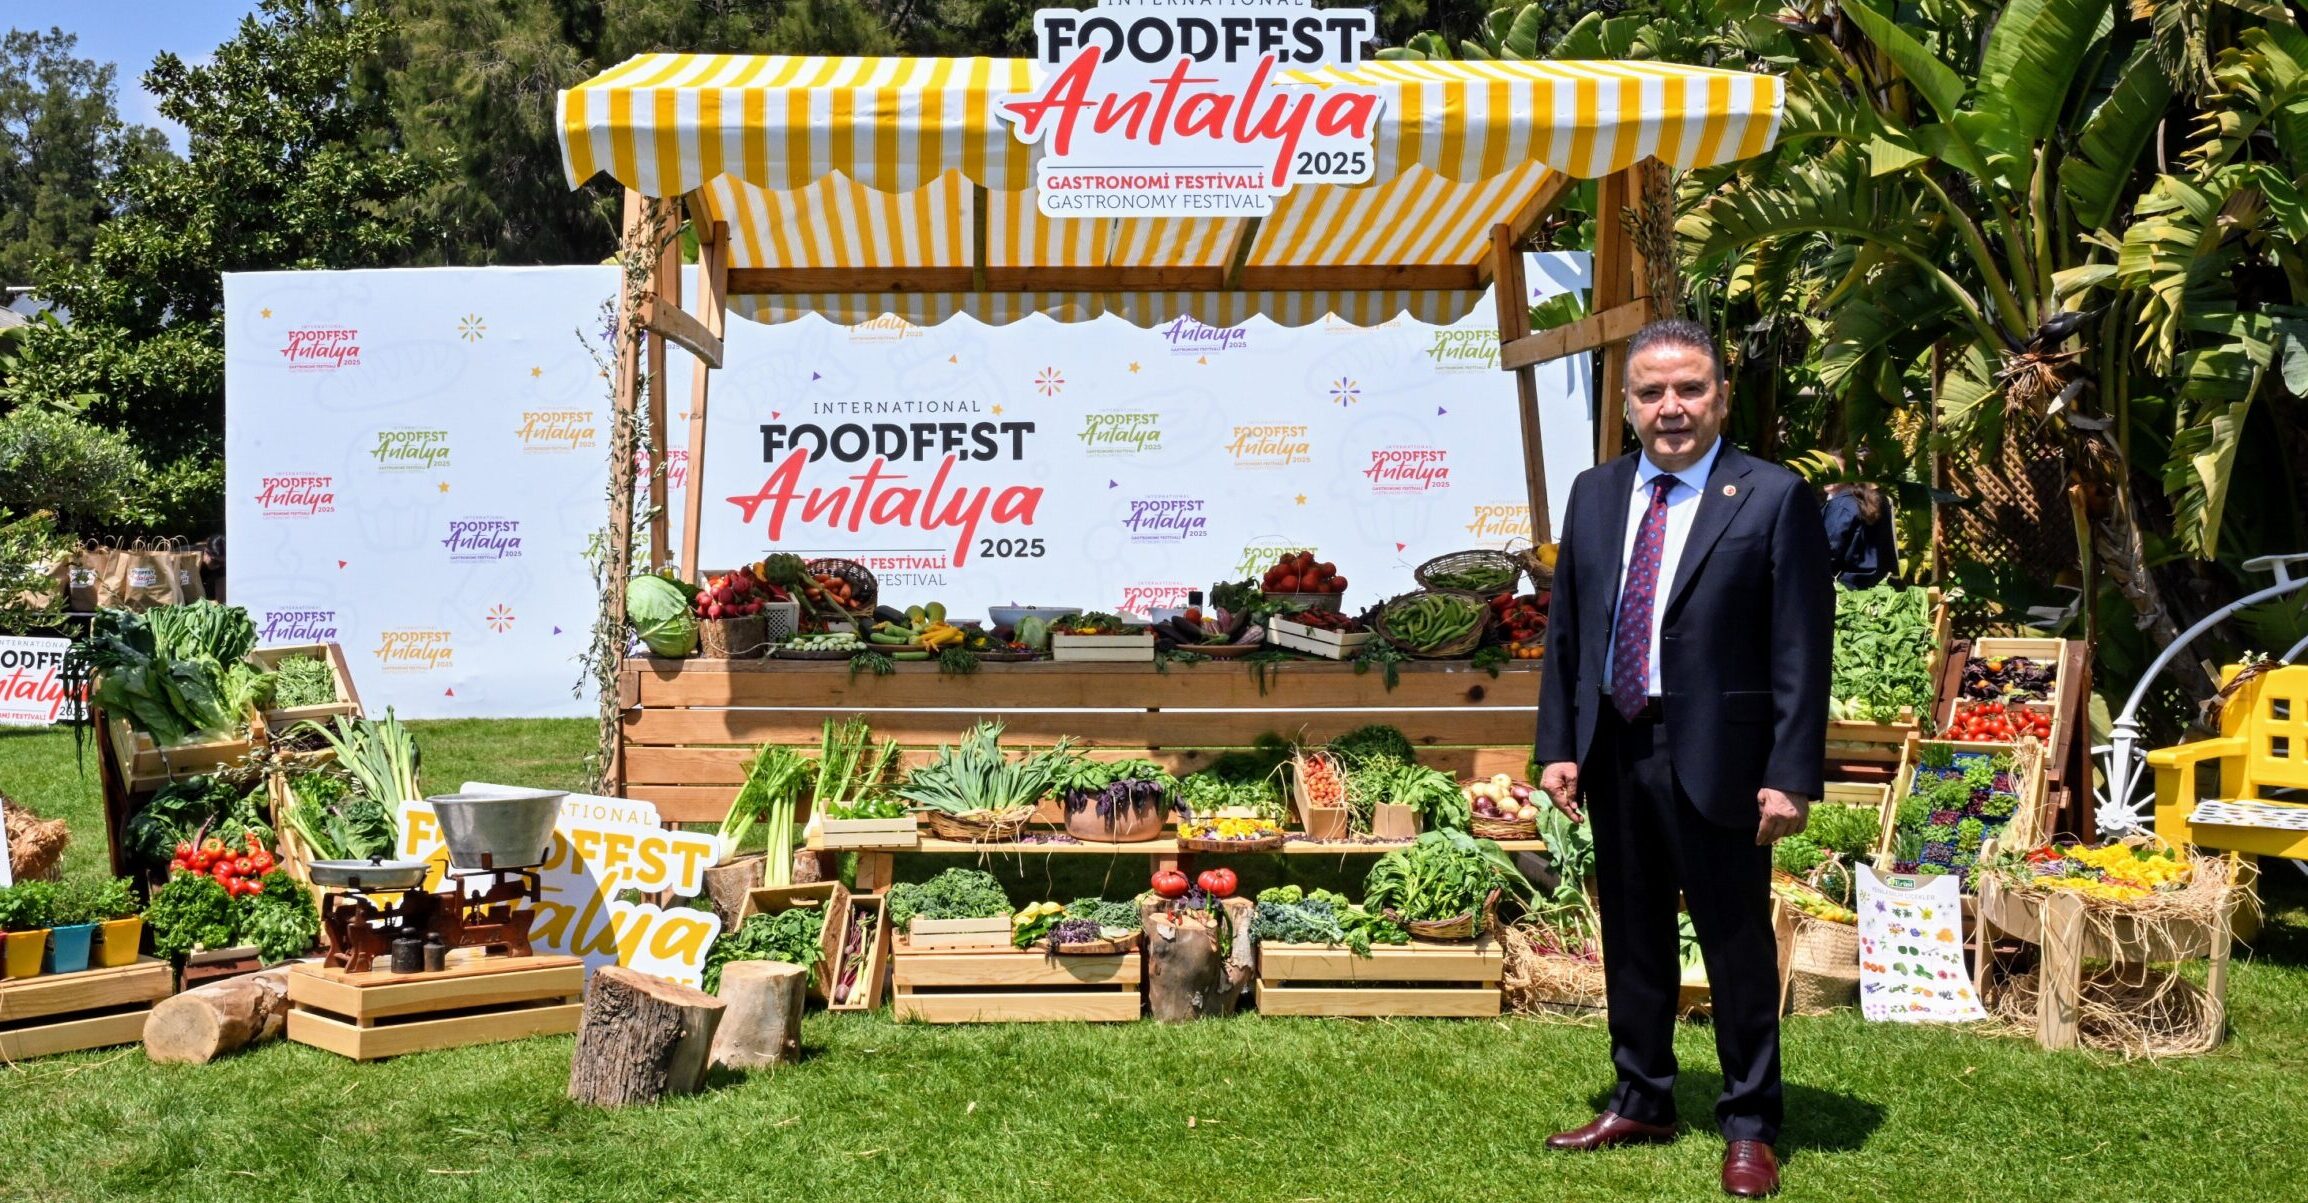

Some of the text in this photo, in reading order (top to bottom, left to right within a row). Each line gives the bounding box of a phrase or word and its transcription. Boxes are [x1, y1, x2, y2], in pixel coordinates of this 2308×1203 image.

[1043, 16, 1367, 64] FOODFEST
[1003, 45, 1377, 188] Antalya
[1296, 151, 1366, 175] 2025
[1046, 172, 1264, 190] GASTRONOMİ FESTİVALİ
[1047, 194, 1264, 209] GASTRONOMY FESTIVAL
[288, 330, 358, 341] FOODFEST
[1434, 330, 1500, 341] FOODFES
[280, 336, 360, 367] Antalya
[1426, 337, 1499, 369] Antaly
[523, 412, 593, 422] FOODFEST
[814, 400, 981, 415] INTERNATIONAL
[1085, 414, 1159, 425] FOODFEST
[378, 431, 448, 442] FOODFEST
[514, 420, 596, 449] Antalya
[1077, 421, 1161, 452] Antalya
[1233, 426, 1307, 437] FOODFEST
[760, 421, 1036, 463] FOODFEST
[1224, 434, 1310, 465] Antalya
[369, 439, 450, 469] Antalya
[1371, 450, 1447, 461] FOODFEST
[262, 477, 332, 488] FOODFEST
[1362, 457, 1449, 490] Antalya
[254, 484, 335, 515] Antalya
[725, 447, 1044, 568] Antalya
[1131, 500, 1205, 511] FOODFEST
[449, 521, 519, 532] FOODFEST
[1122, 507, 1207, 539] Antalya
[441, 528, 522, 559] Antalya
[980, 538, 1046, 558] 2025
[870, 554, 947, 569] FESTİVALİ
[878, 573, 947, 586] FESTIVAL
[266, 611, 336, 622] FOODFEST
[258, 618, 337, 643] Antalya
[382, 632, 451, 642] FOODFEST
[373, 640, 453, 670] Antalya
